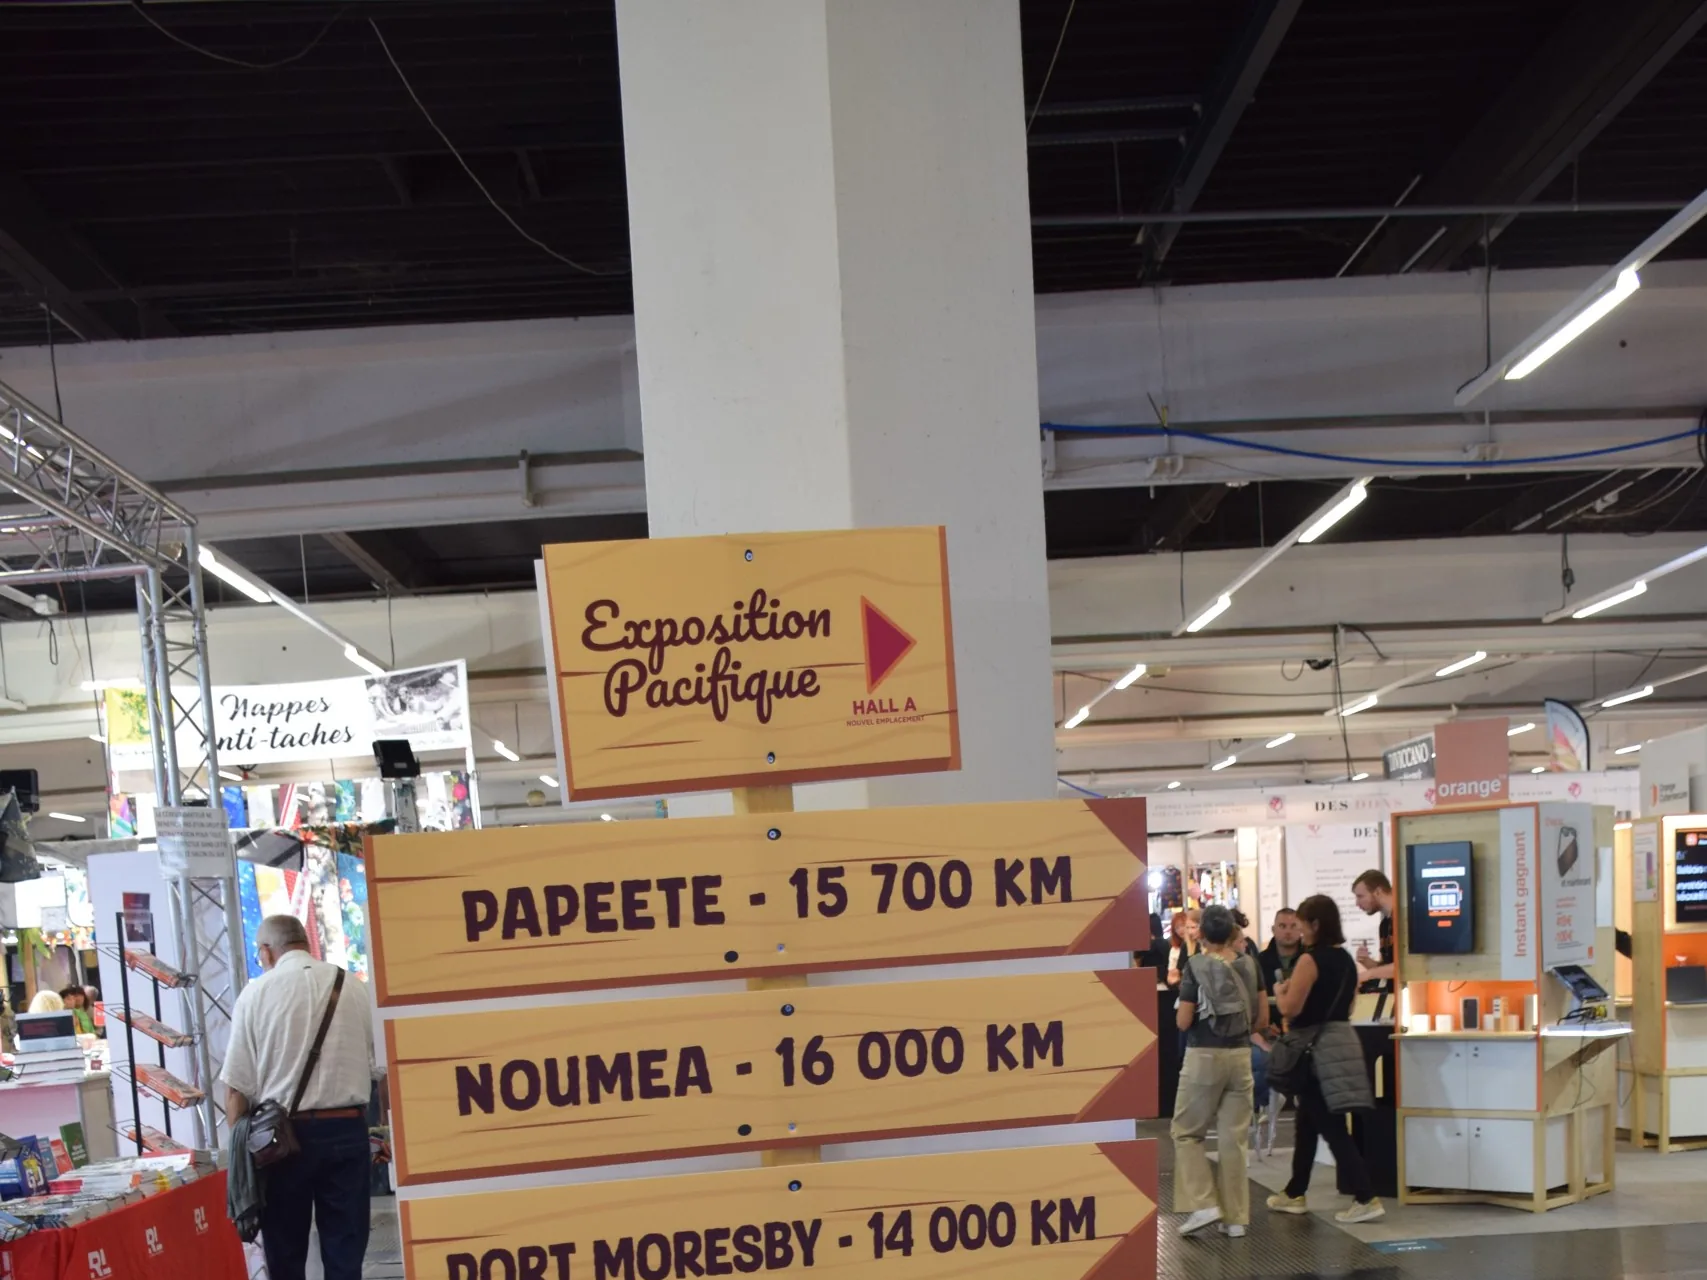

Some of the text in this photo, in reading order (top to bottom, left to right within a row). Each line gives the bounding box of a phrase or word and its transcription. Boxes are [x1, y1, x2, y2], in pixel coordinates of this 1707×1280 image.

[581, 588, 831, 676] Exposition
[220, 693, 332, 723] Nappes
[604, 646, 820, 724] Pacifique
[852, 696, 917, 715] HALL A
[846, 715, 925, 727] NOUVEL EMPLACEMENT
[1315, 800, 1349, 812] DES
[1438, 778, 1501, 798] orange
[462, 855, 1072, 942] PAPEETE - 15 700 KM
[1514, 831, 1528, 957] Instant gagnant
[455, 1020, 1064, 1116] NOUMEA - 16 000 KM
[838, 1234, 853, 1248] -
[867, 1209, 914, 1259] 14
[929, 1201, 1016, 1253] 000
[1031, 1196, 1096, 1246] KM
[88, 1248, 112, 1280] RL
